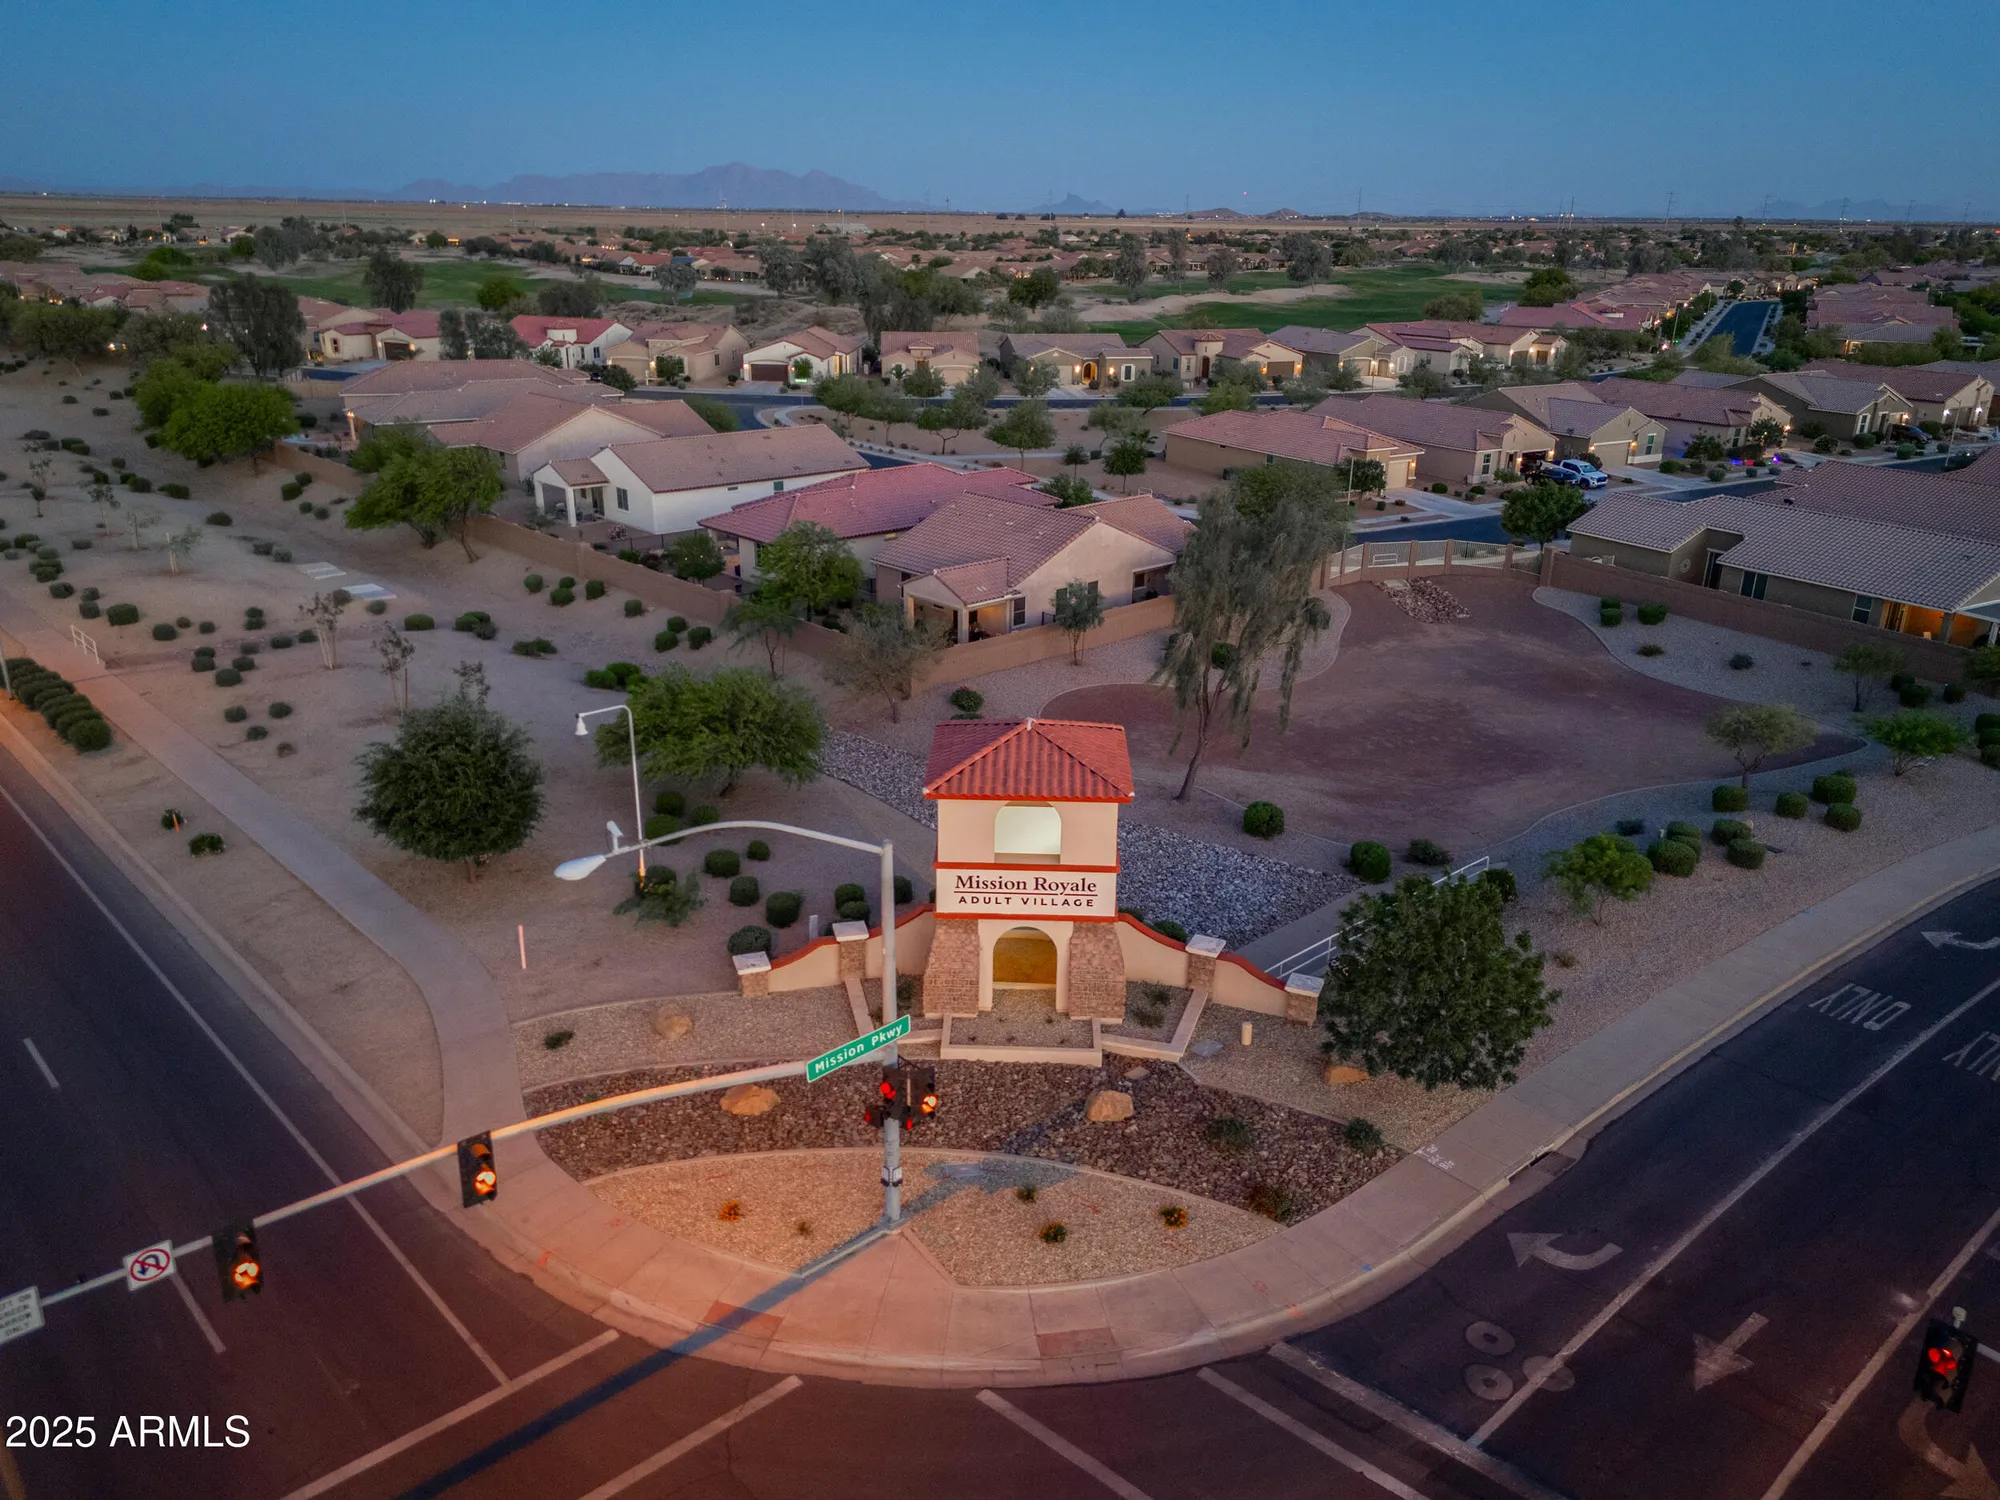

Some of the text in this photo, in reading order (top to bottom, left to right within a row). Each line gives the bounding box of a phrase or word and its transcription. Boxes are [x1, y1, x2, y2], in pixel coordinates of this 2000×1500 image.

[955, 875, 1097, 895] Mission Royale
[959, 896, 1094, 907] ADULT VILLAGE
[1808, 983, 1911, 1031] ONLY
[815, 1024, 902, 1073] Mission Pkwy
